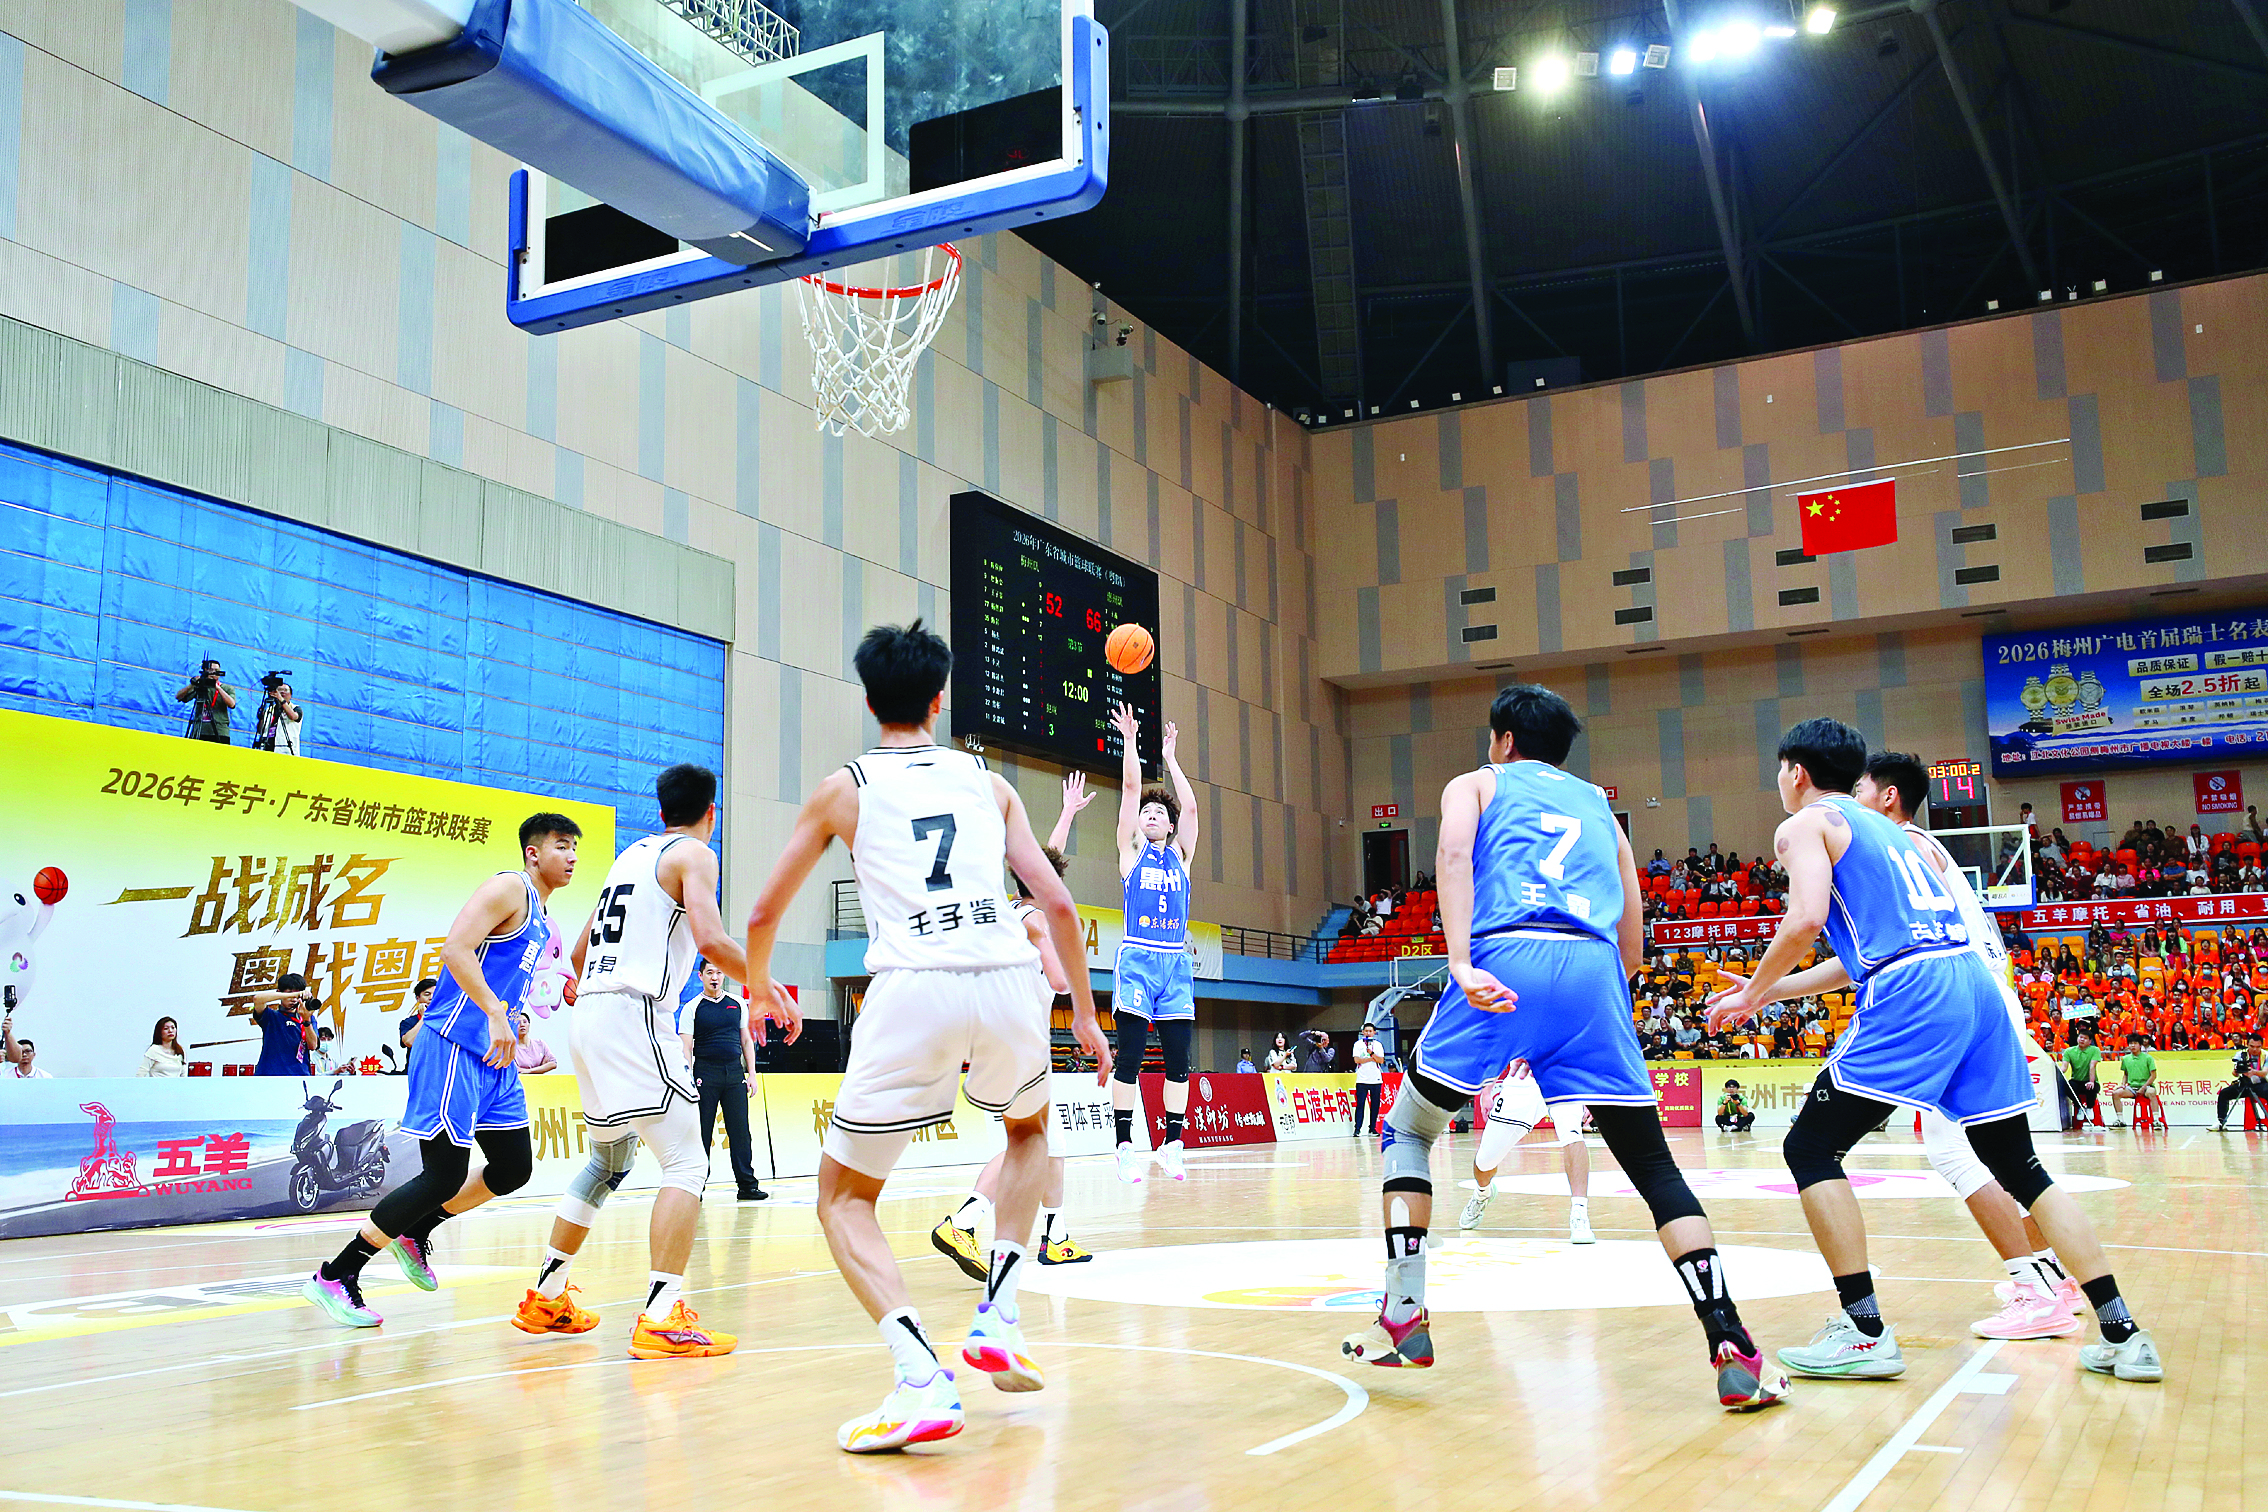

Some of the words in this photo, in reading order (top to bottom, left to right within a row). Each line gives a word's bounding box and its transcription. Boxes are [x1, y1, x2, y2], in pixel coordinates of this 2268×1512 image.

[1046, 592, 1063, 618] 52
[1998, 619, 2268, 664] 2026梅州广电首届瑞士名表
[2137, 658, 2190, 673] 品质保证
[2214, 650, 2268, 666] 假一赔十
[1062, 680, 1089, 702] 12:00
[2055, 716, 2080, 725] Swiss
[2082, 711, 2106, 720] Made
[1928, 763, 1981, 779] 03:00.2
[1942, 776, 1975, 801] 14
[101, 768, 205, 806] 2026年
[210, 781, 492, 845] 李宁·广东省城市篮球联赛
[1373, 805, 1397, 817] 出口
[2211, 802, 2238, 810] SMOKING
[911, 813, 957, 892] 7
[1539, 812, 1582, 880] 7
[1140, 867, 1182, 892] 惠州
[97, 853, 404, 939] 一战城名
[1159, 895, 1168, 913] 5
[1401, 944, 1433, 957] D2区
[1133, 988, 1143, 1007] 5
[152, 1132, 250, 1178] 五羊
[153, 1177, 253, 1195] WUYANG
